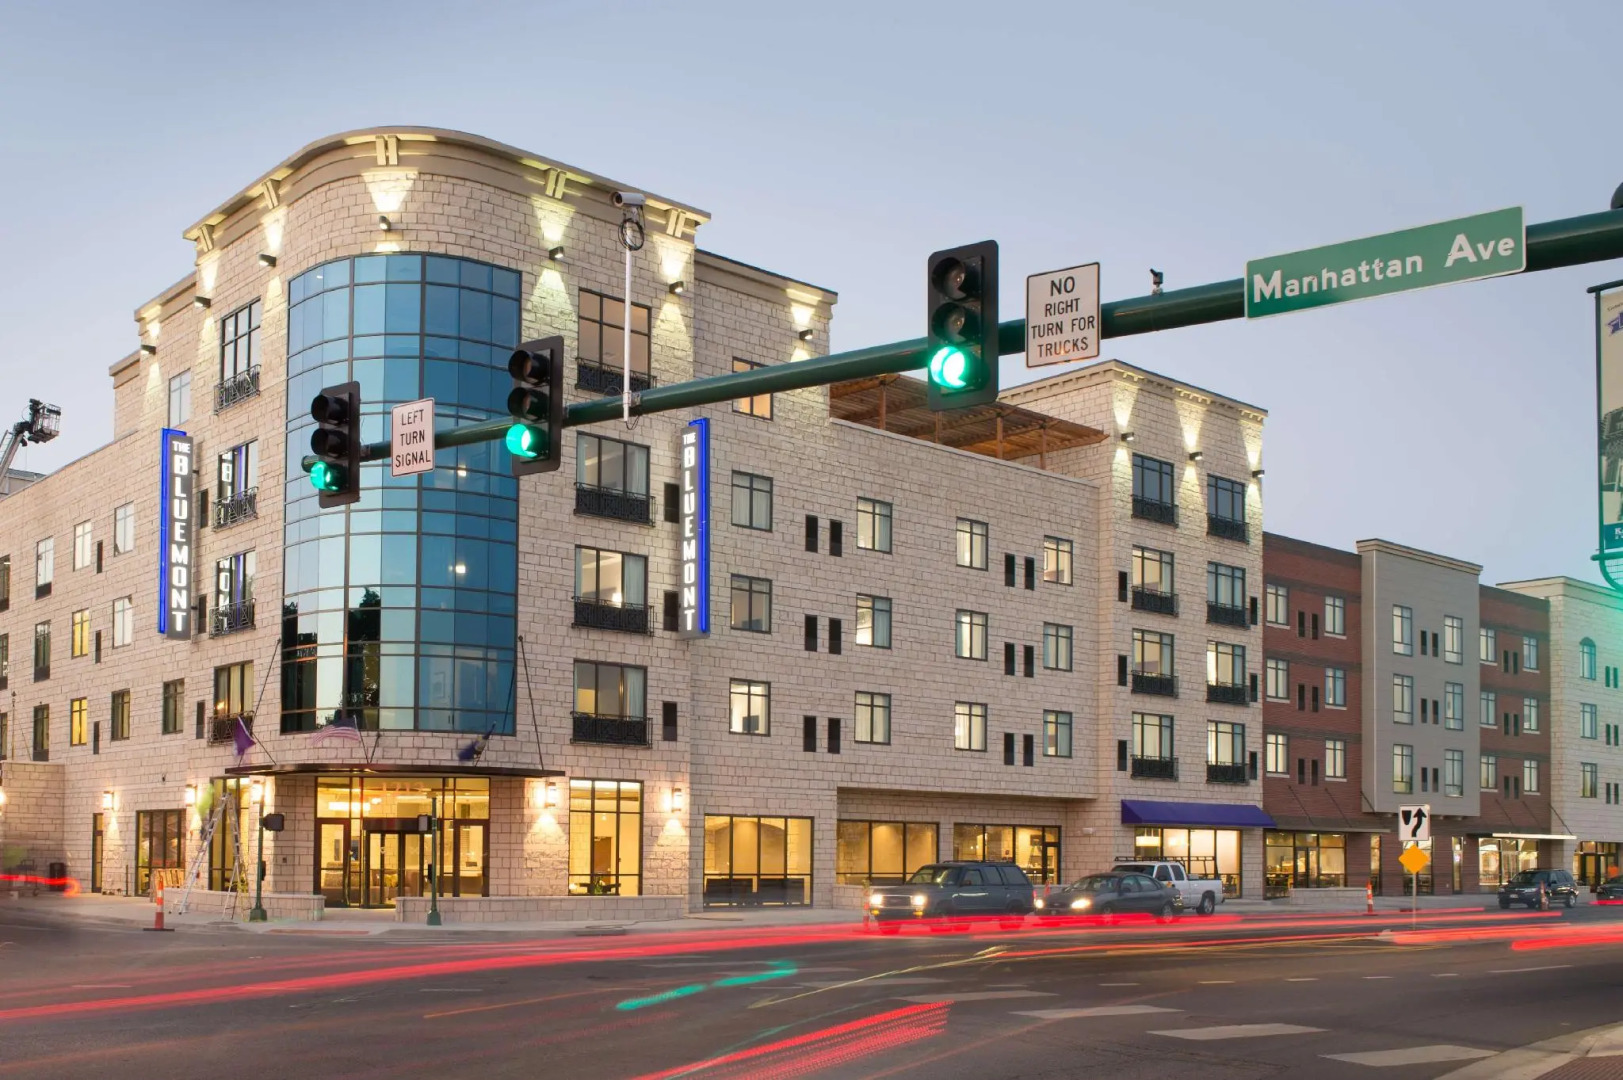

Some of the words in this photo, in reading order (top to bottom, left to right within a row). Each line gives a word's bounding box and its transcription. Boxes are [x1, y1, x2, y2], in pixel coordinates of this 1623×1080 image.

[1253, 254, 1422, 303] Manhattan
[1444, 233, 1515, 268] Ave
[1050, 276, 1075, 296] NO
[1045, 298, 1080, 317] RIGHT
[1031, 321, 1063, 339] TURN
[1071, 315, 1095, 332] FOR
[1038, 336, 1088, 357] TRUCKS
[401, 409, 424, 425] LEFT
[172, 440, 190, 454] THE
[400, 429, 425, 446] TURN
[682, 432, 696, 445] THE
[395, 450, 431, 467] SIGNAL
[171, 454, 188, 631] BLUEMONT
[683, 446, 696, 630] BLUEMONT
